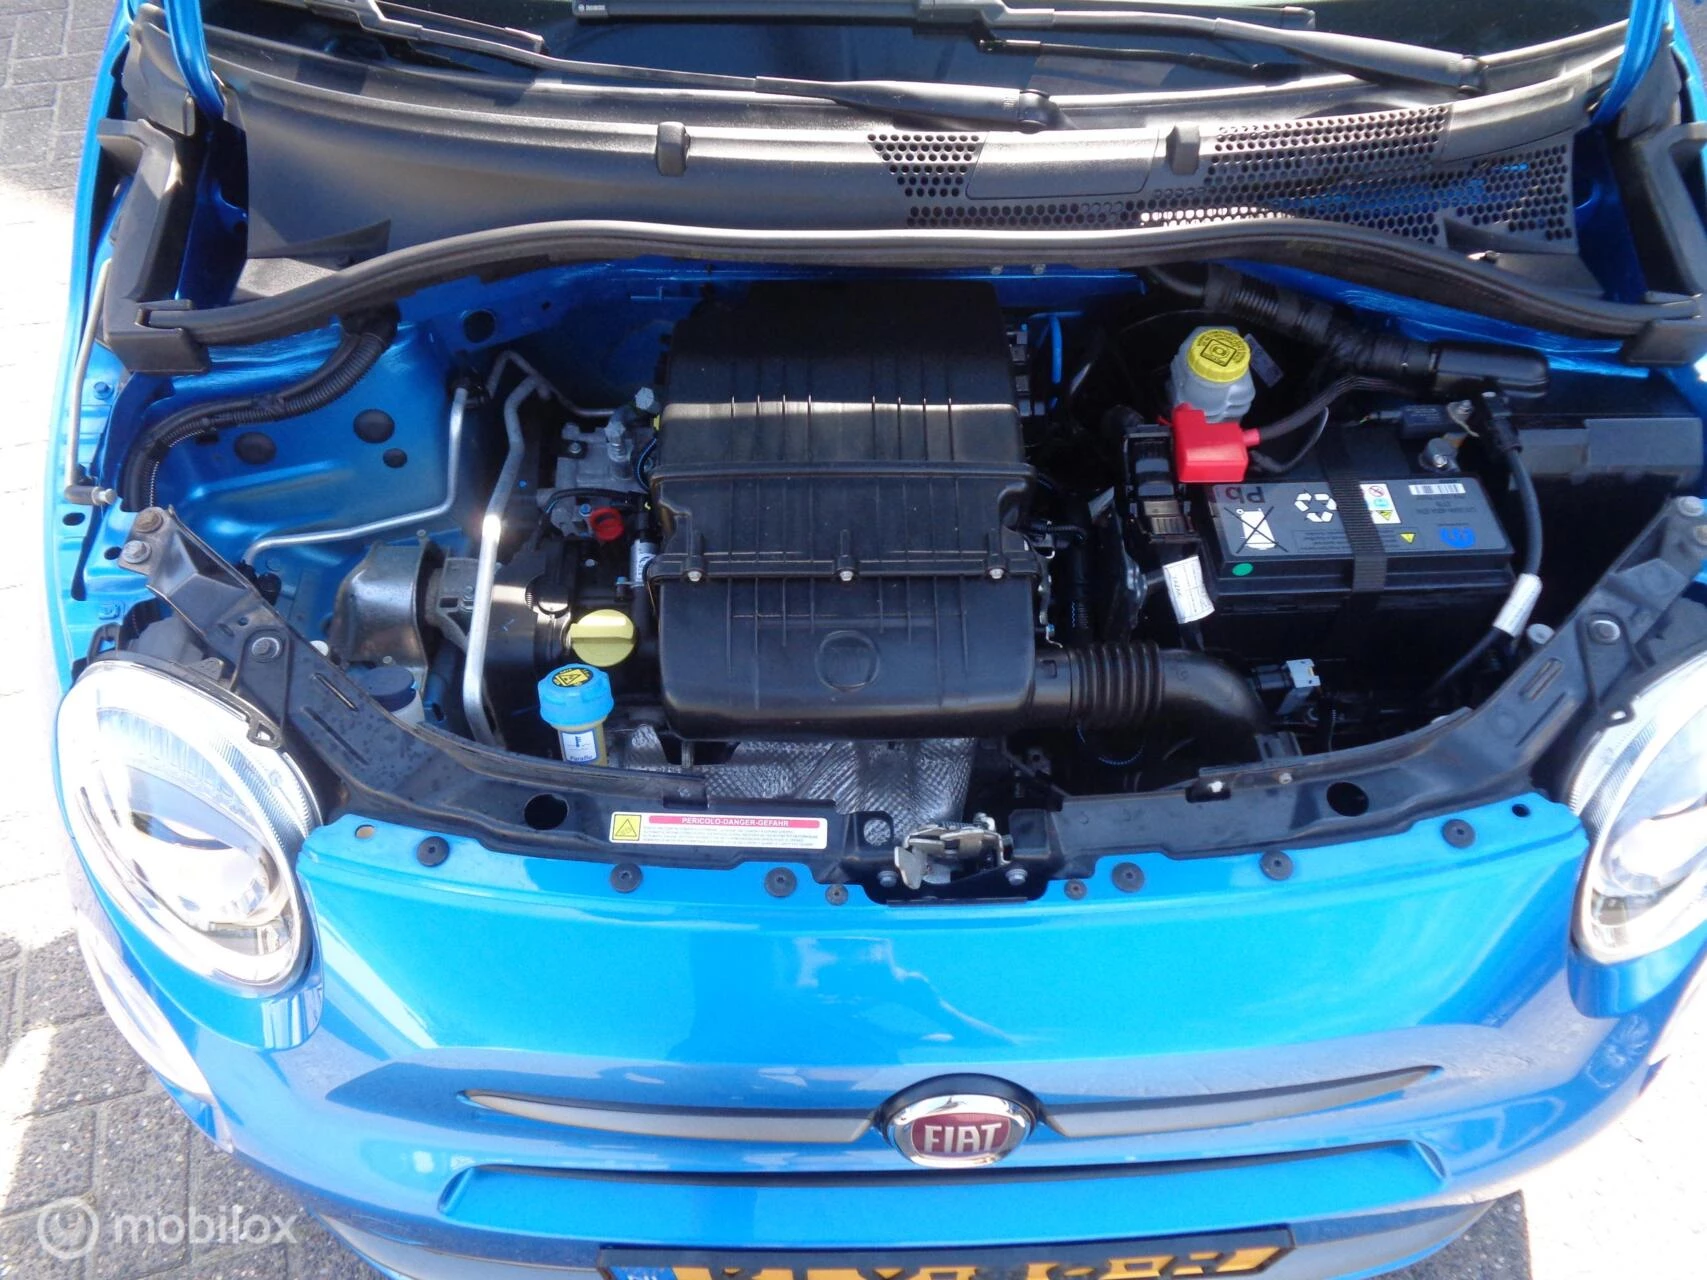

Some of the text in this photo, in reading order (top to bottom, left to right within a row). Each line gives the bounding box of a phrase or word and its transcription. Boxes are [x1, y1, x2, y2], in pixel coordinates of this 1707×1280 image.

[1225, 486, 1266, 504] Pb
[681, 816, 789, 828] PERICOLO-DANGER-GEFAHR
[924, 1123, 1002, 1153] FIAT
